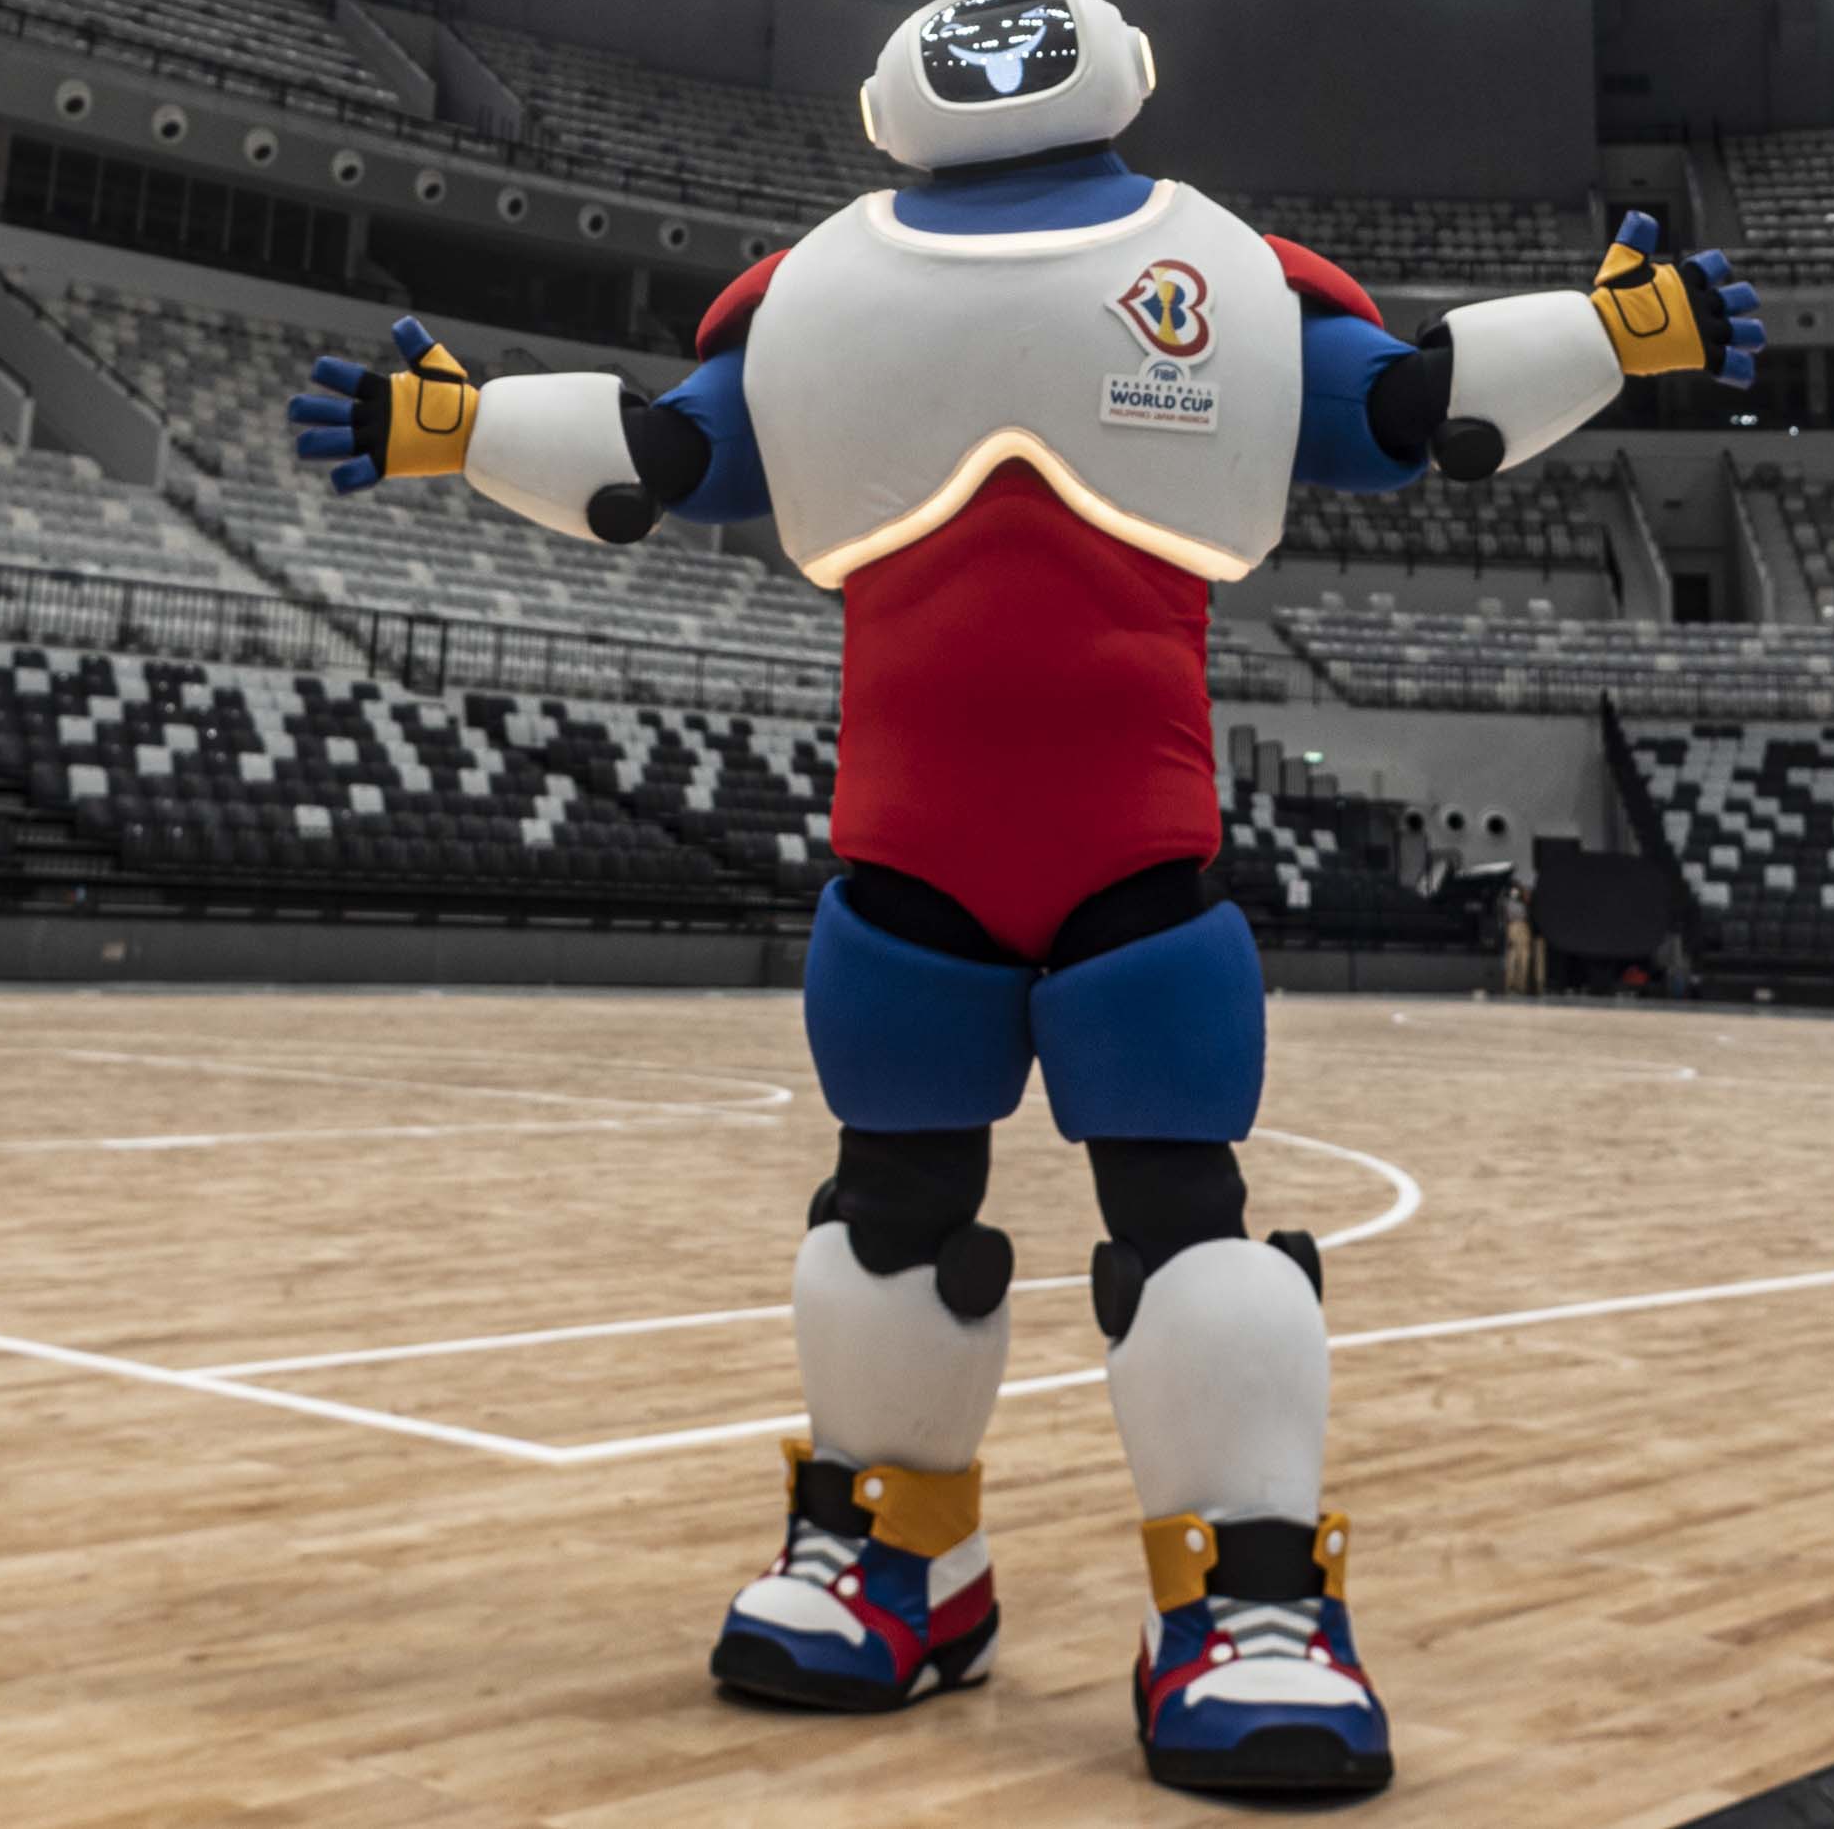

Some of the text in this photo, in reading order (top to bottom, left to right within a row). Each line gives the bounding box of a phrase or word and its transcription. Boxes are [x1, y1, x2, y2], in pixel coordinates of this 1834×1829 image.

[1154, 368, 1178, 381] FIBA
[1111, 380, 1211, 396] BASKETBALL
[1110, 389, 1214, 412] WORLD CUP
